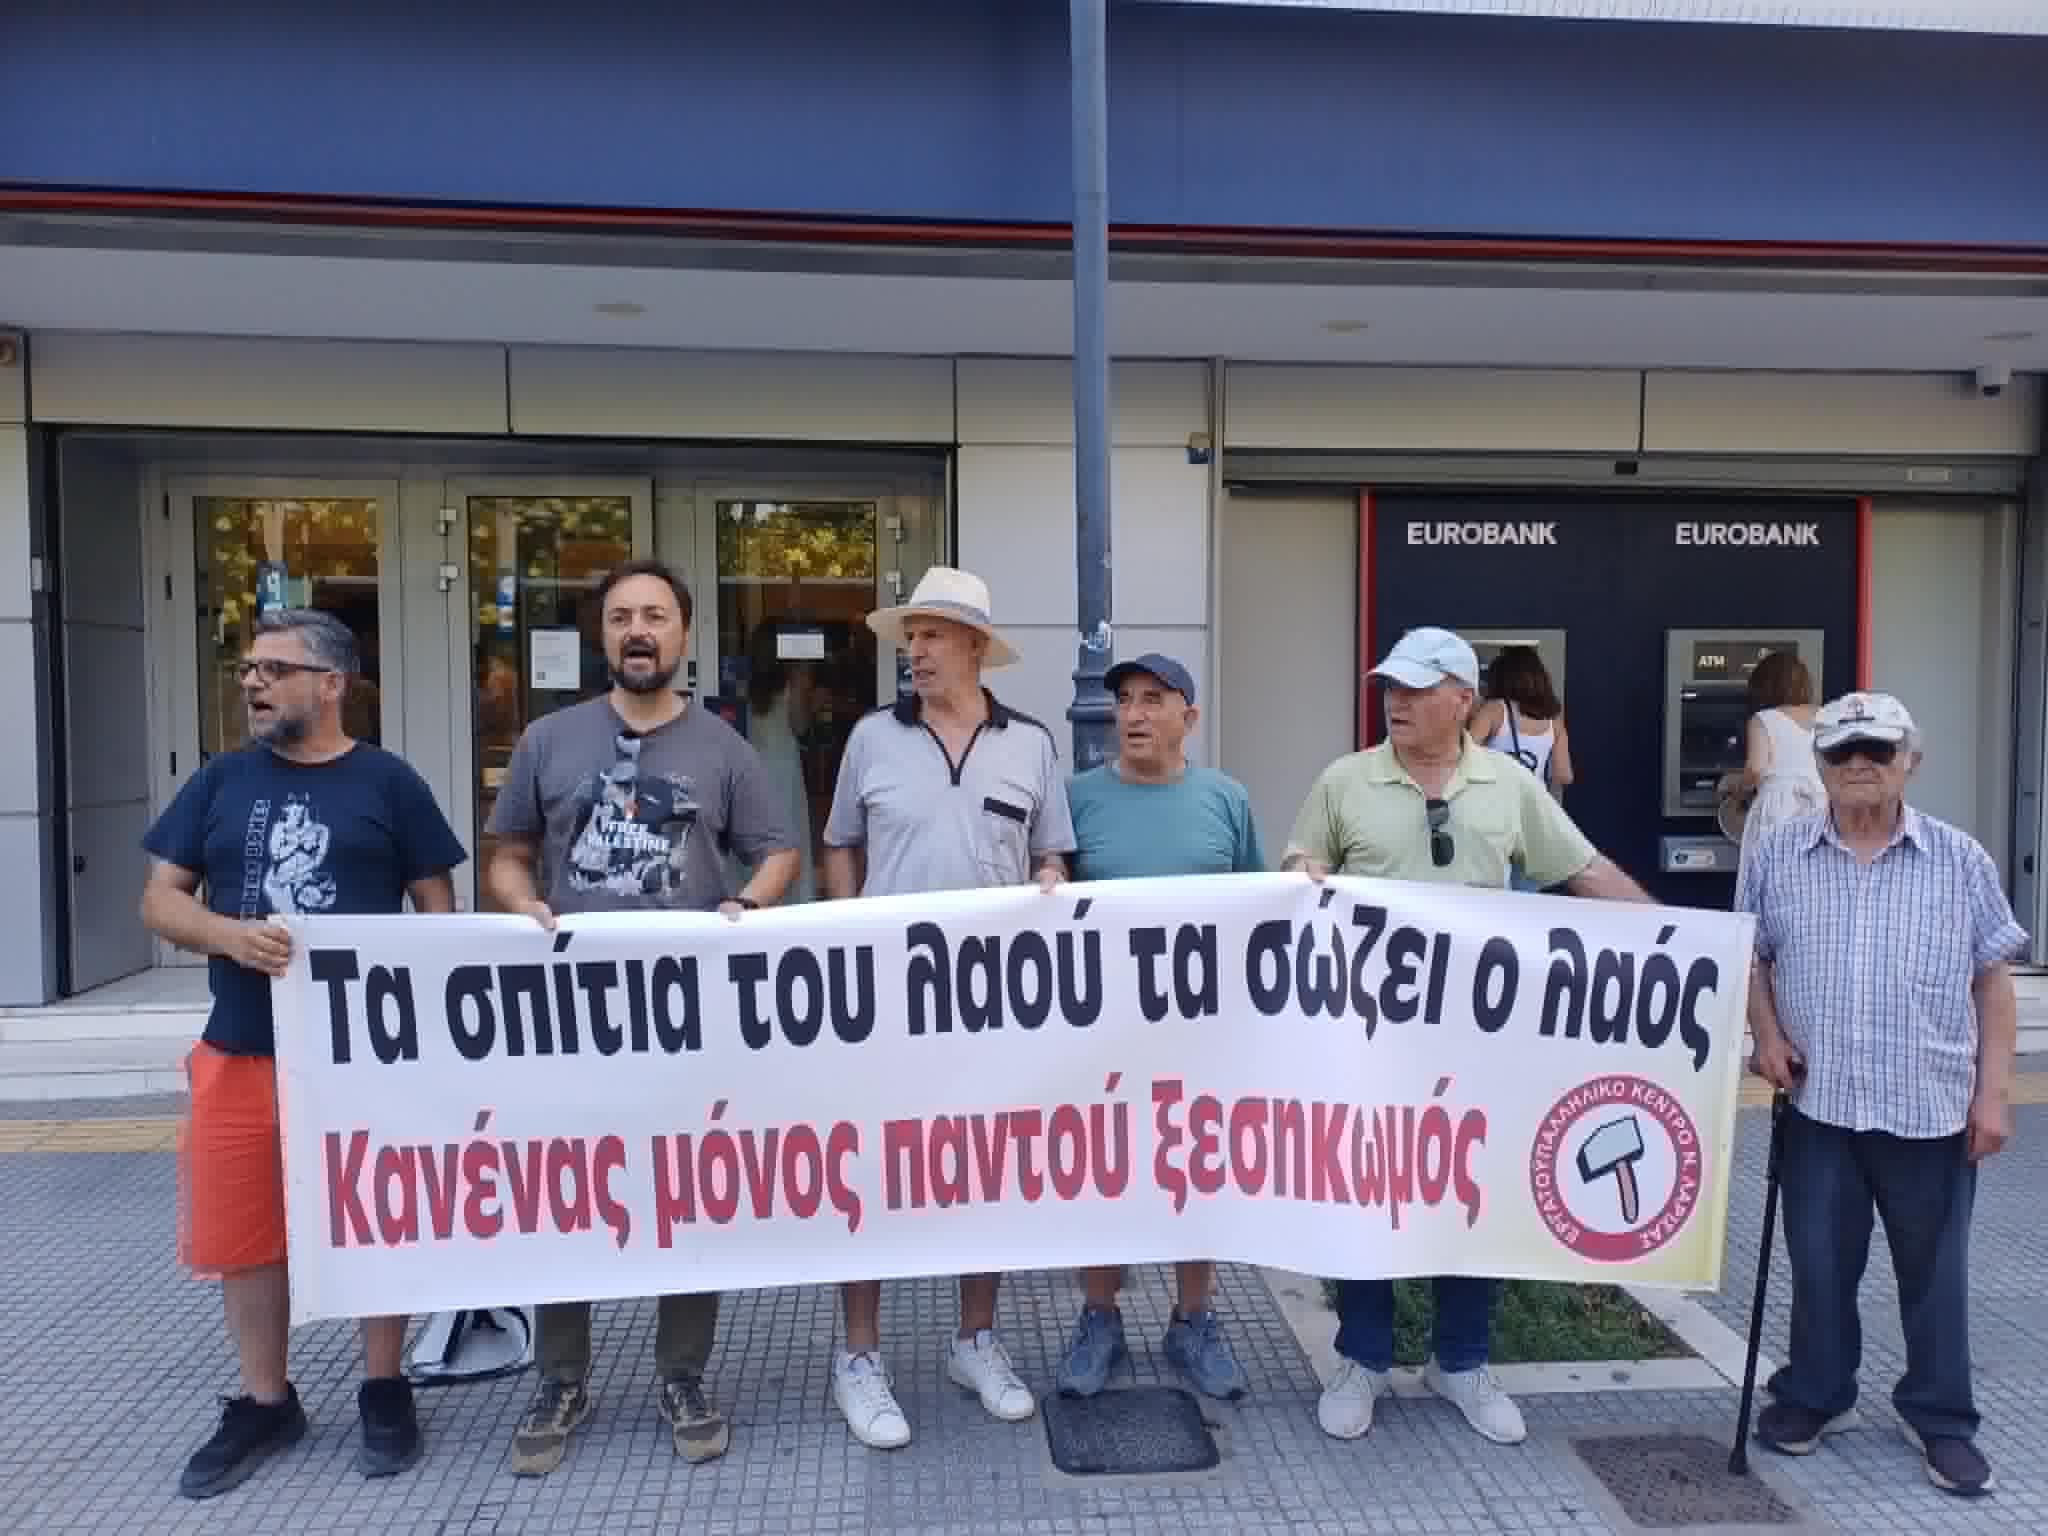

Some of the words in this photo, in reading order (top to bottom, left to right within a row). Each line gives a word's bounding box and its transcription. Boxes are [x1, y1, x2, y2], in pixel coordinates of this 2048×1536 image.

[1406, 521, 1559, 546] EUROBANK
[1675, 522, 1821, 546] EUROBANK
[1697, 654, 1726, 668] ATM
[309, 947, 419, 1065] Τα
[444, 931, 702, 1061] σπίτια
[727, 944, 875, 1049] του
[906, 899, 1104, 1036] λαού
[1129, 924, 1219, 1022] τα
[1245, 889, 1451, 1041] σώζει
[1538, 925, 1719, 1073] λαός
[1631, 1083, 1693, 1145] ΚΕΝΤΡΟ
[323, 1110, 631, 1249] Κανένας
[651, 1099, 865, 1249] μόνος
[882, 1072, 1130, 1210] παντού
[1151, 1079, 1488, 1231] ξεσηκωμός
